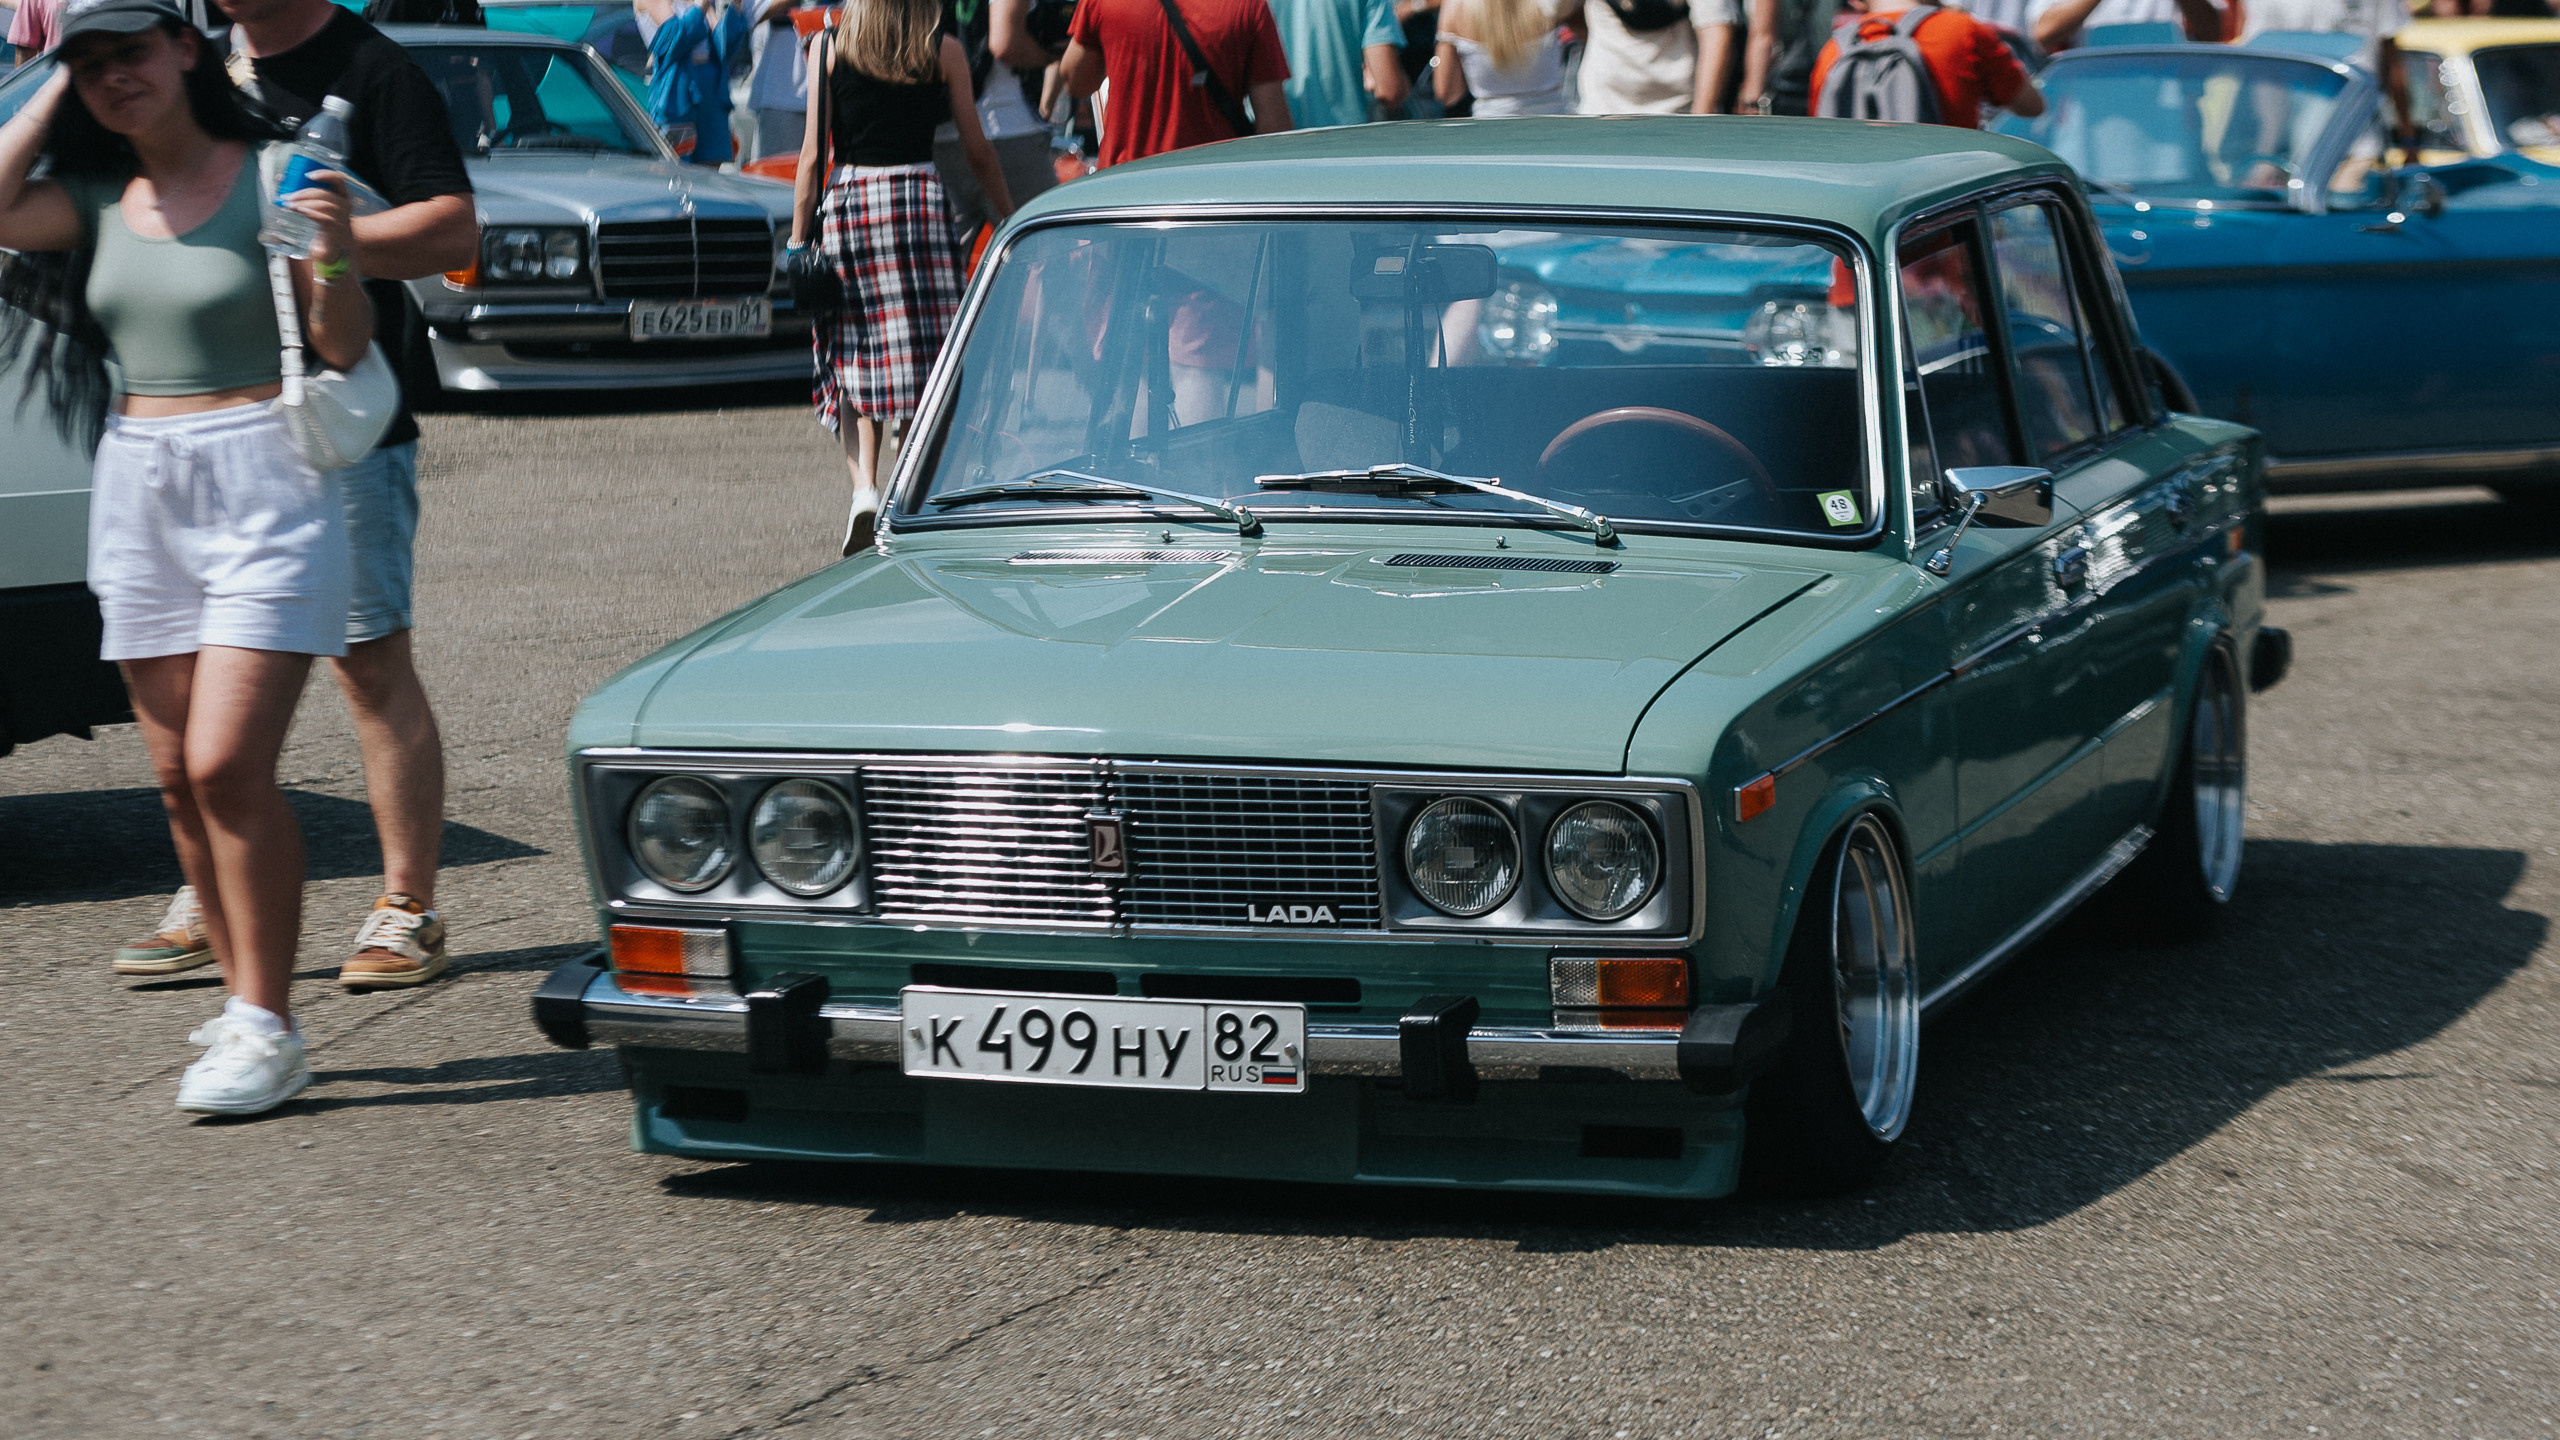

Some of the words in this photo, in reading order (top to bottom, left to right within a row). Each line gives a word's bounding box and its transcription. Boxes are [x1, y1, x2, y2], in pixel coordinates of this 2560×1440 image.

[1831, 498, 1848, 511] 48
[1247, 904, 1337, 924] LADA
[1214, 1010, 1280, 1063] 82
[1211, 1064, 1260, 1083] RUS
